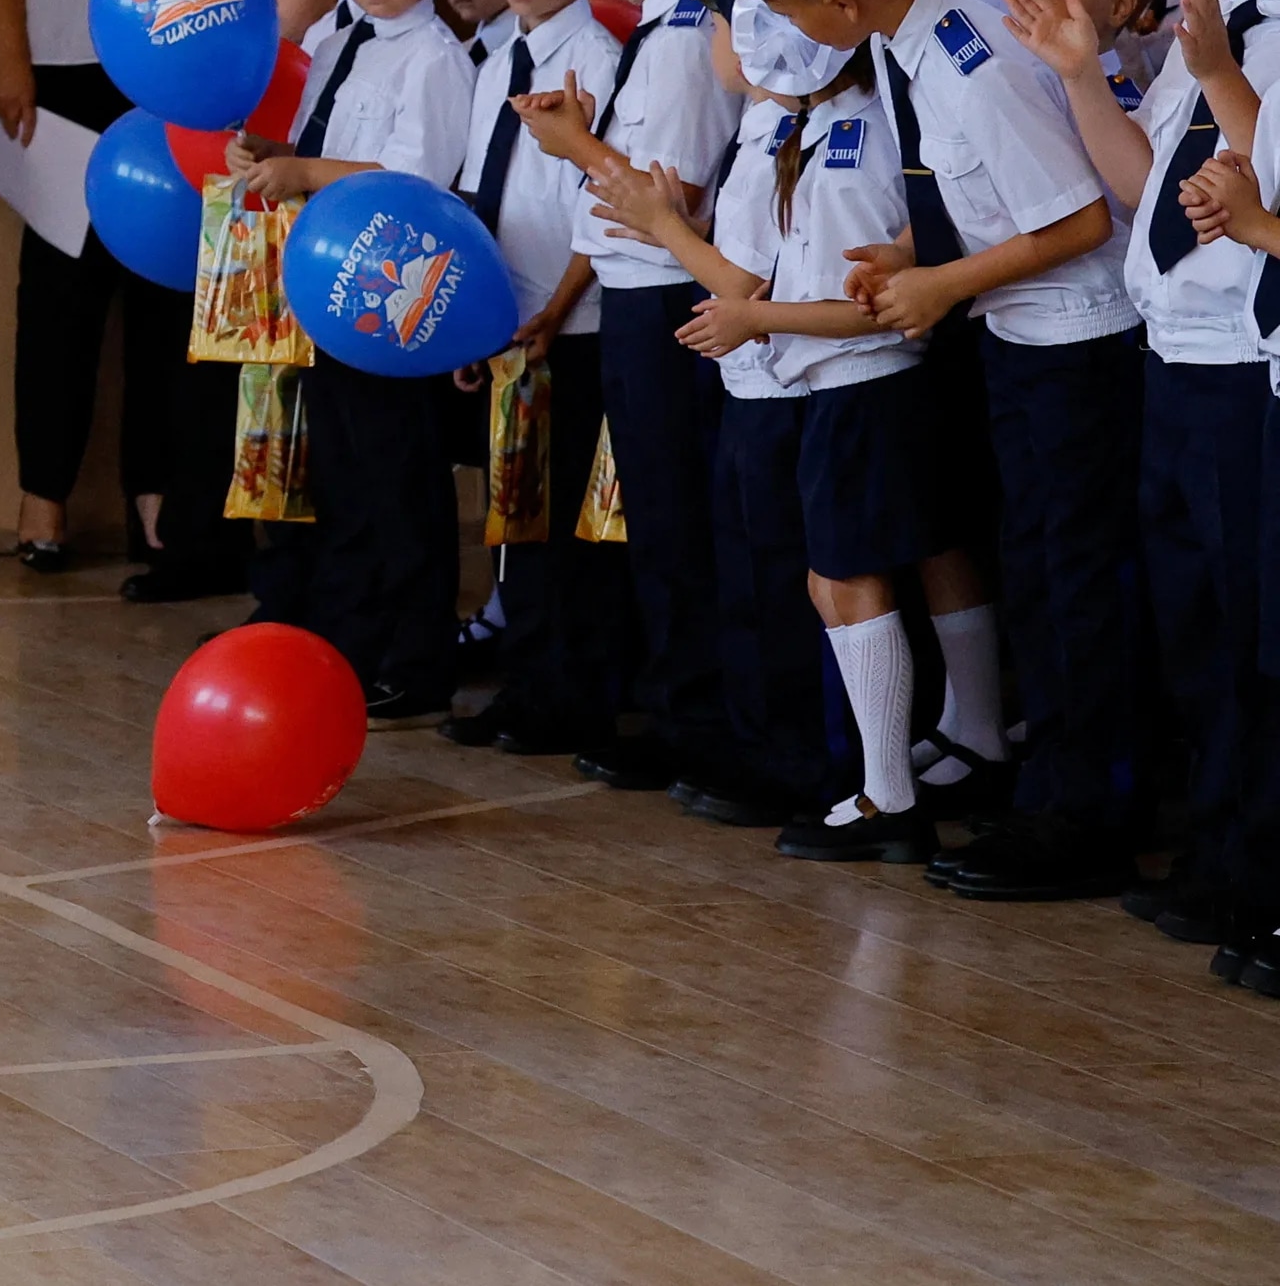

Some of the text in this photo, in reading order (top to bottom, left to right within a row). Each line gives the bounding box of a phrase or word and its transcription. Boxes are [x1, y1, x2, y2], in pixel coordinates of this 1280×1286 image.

[165, 4, 238, 45] ШКОЛА!
[952, 37, 985, 67] КШИ
[826, 148, 858, 160] КШИ
[416, 264, 465, 343] ШКОЛА!
